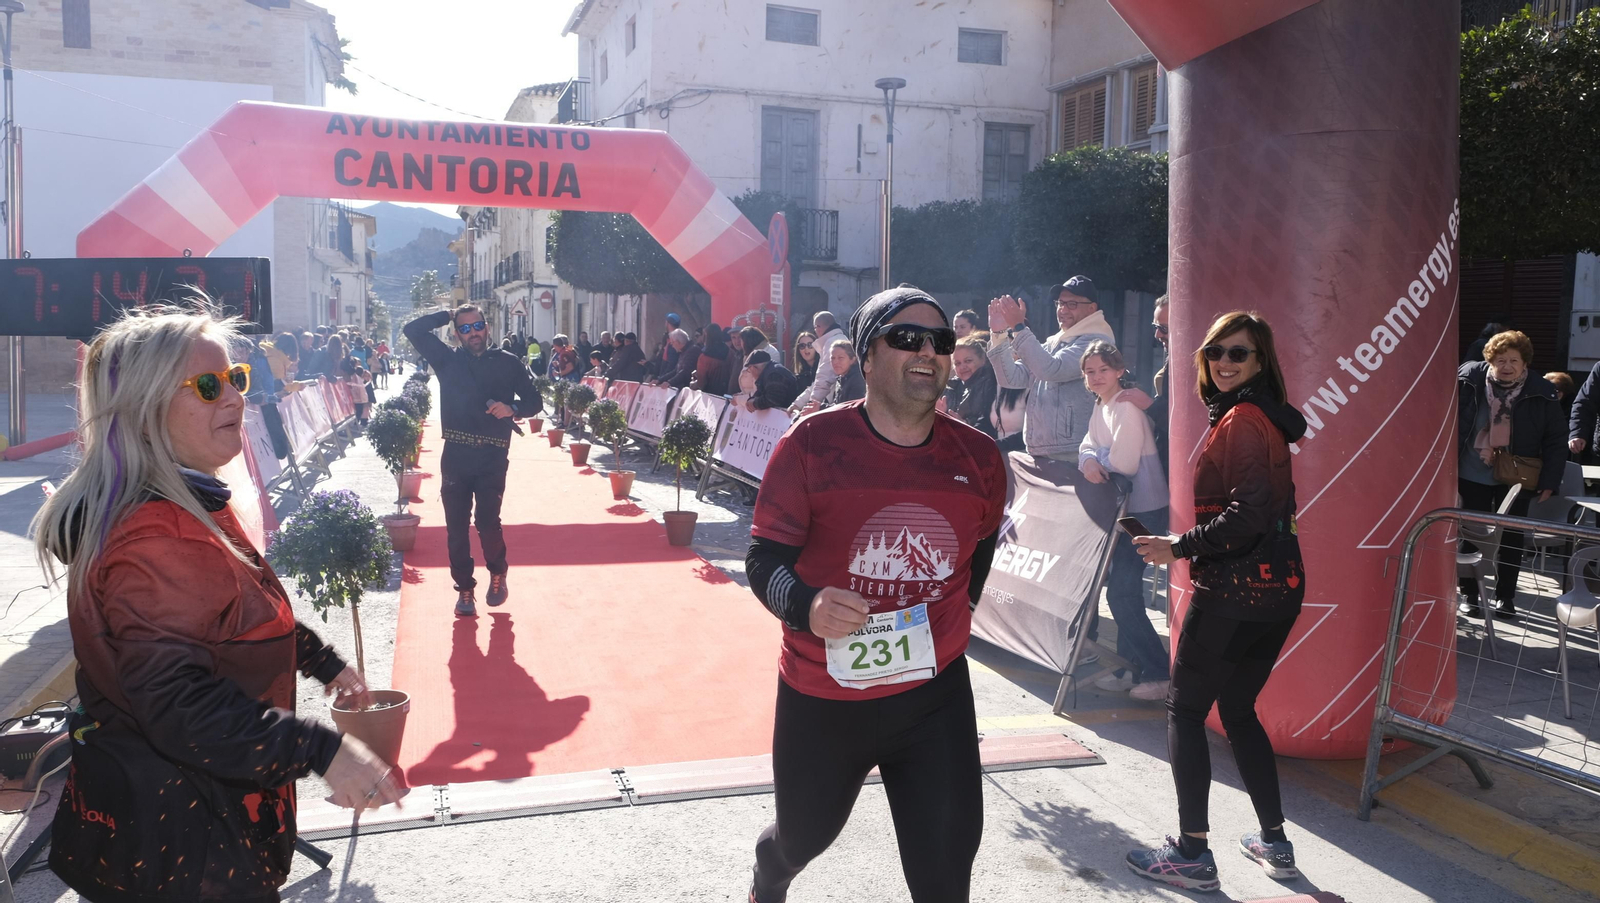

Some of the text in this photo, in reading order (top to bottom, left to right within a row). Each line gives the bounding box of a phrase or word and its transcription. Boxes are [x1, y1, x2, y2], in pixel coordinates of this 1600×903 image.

[325, 114, 591, 151] AYUNTAMIENTO
[333, 148, 582, 199] CANTORIA
[1287, 198, 1460, 456] ww.teamergy.es
[729, 428, 778, 461] CANTOR
[850, 577, 906, 597] SIERRO
[848, 634, 911, 670] 231
